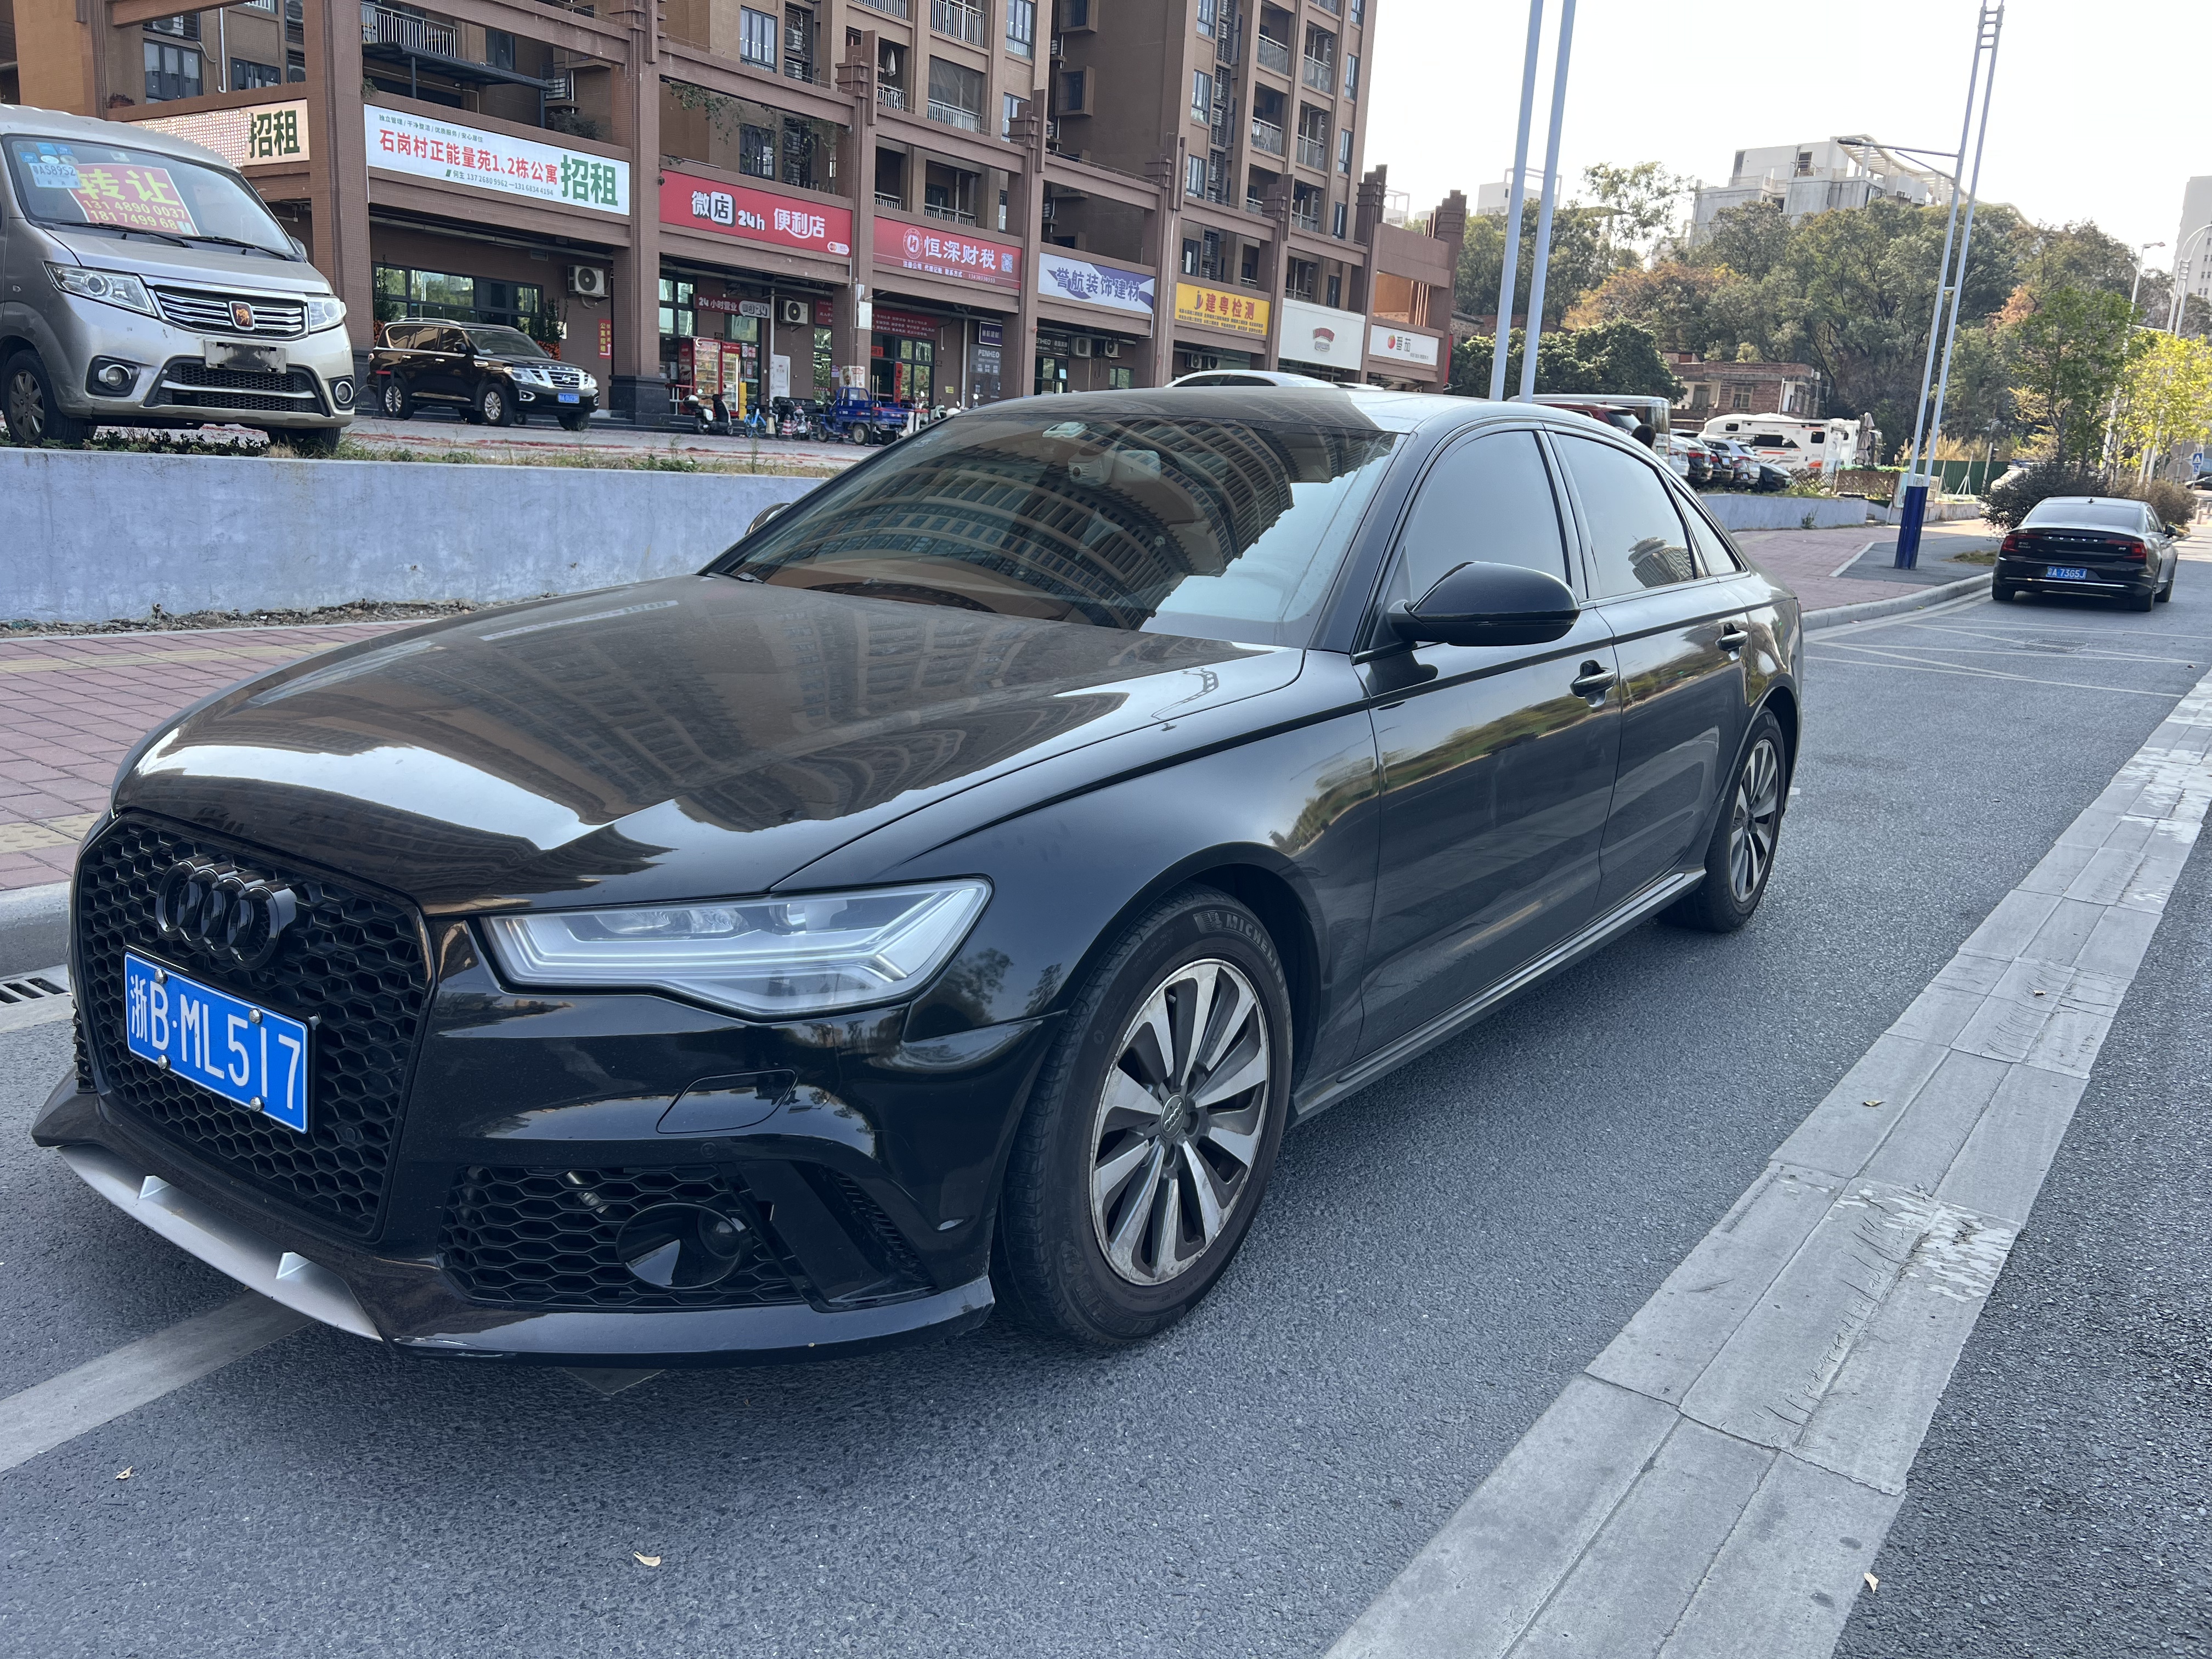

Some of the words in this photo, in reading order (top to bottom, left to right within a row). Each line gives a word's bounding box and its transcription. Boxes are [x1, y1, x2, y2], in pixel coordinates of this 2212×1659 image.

[249, 110, 300, 159] 招租
[78, 168, 179, 205] 转让
[561, 154, 618, 206] 招租
[83, 200, 110, 210] 131
[115, 202, 150, 214] 4890
[153, 206, 185, 219] 0037
[91, 210, 117, 222] 181
[122, 213, 157, 227] 7499
[774, 208, 825, 239] 便利店
[924, 235, 996, 270] 恒深财税
[1056, 267, 1140, 302] 誉航装饰建材
[1205, 293, 1255, 320] 建粤检测
[1396, 336, 1411, 352] 番茄
[1226, 913, 1283, 984] MICHELIN
